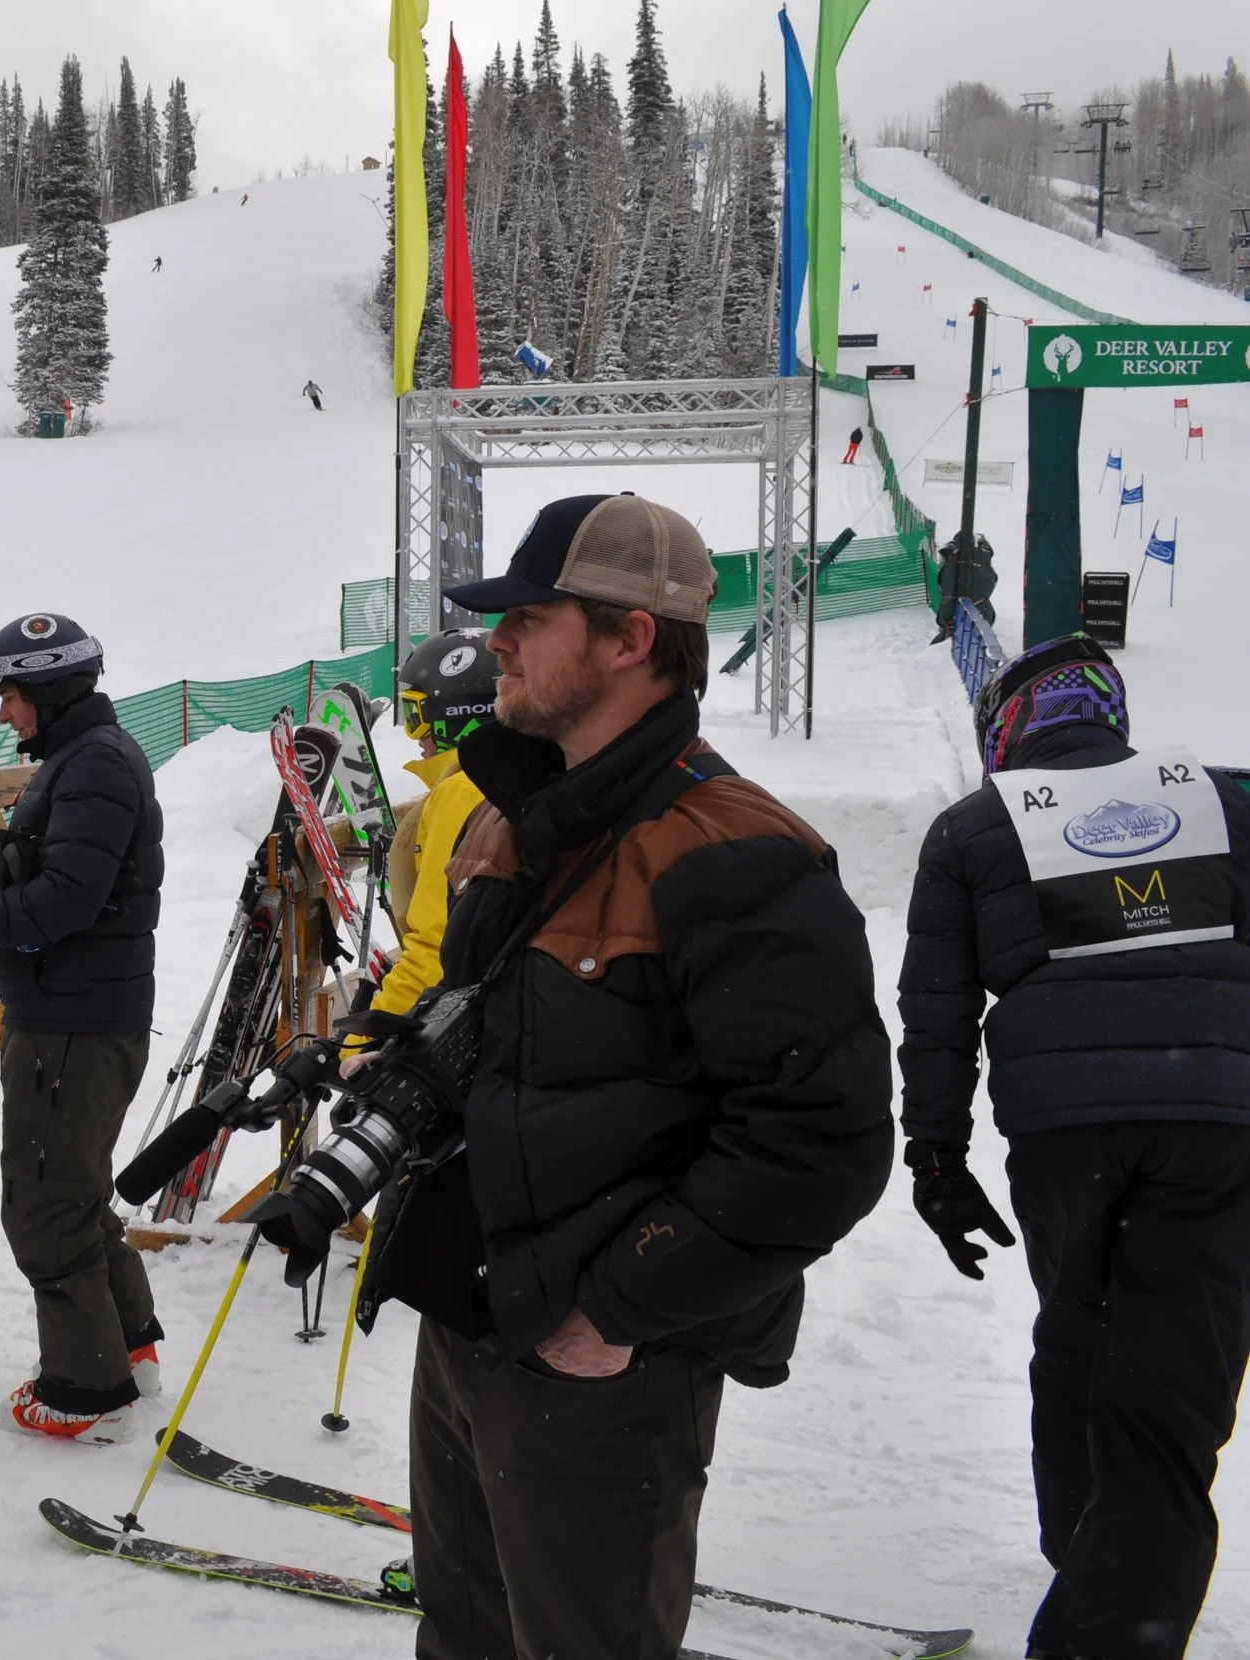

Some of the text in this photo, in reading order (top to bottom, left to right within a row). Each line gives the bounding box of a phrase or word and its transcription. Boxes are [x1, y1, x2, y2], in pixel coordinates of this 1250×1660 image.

[1095, 340, 1233, 356] DEER VALLEY
[1122, 359, 1203, 375] RESORT
[1157, 763, 1196, 787] A2
[1022, 786, 1059, 813] A2
[1071, 813, 1170, 840] Deer Valley
[1082, 827, 1160, 847] Celebrity Skifest
[1122, 904, 1170, 921] MITCH
